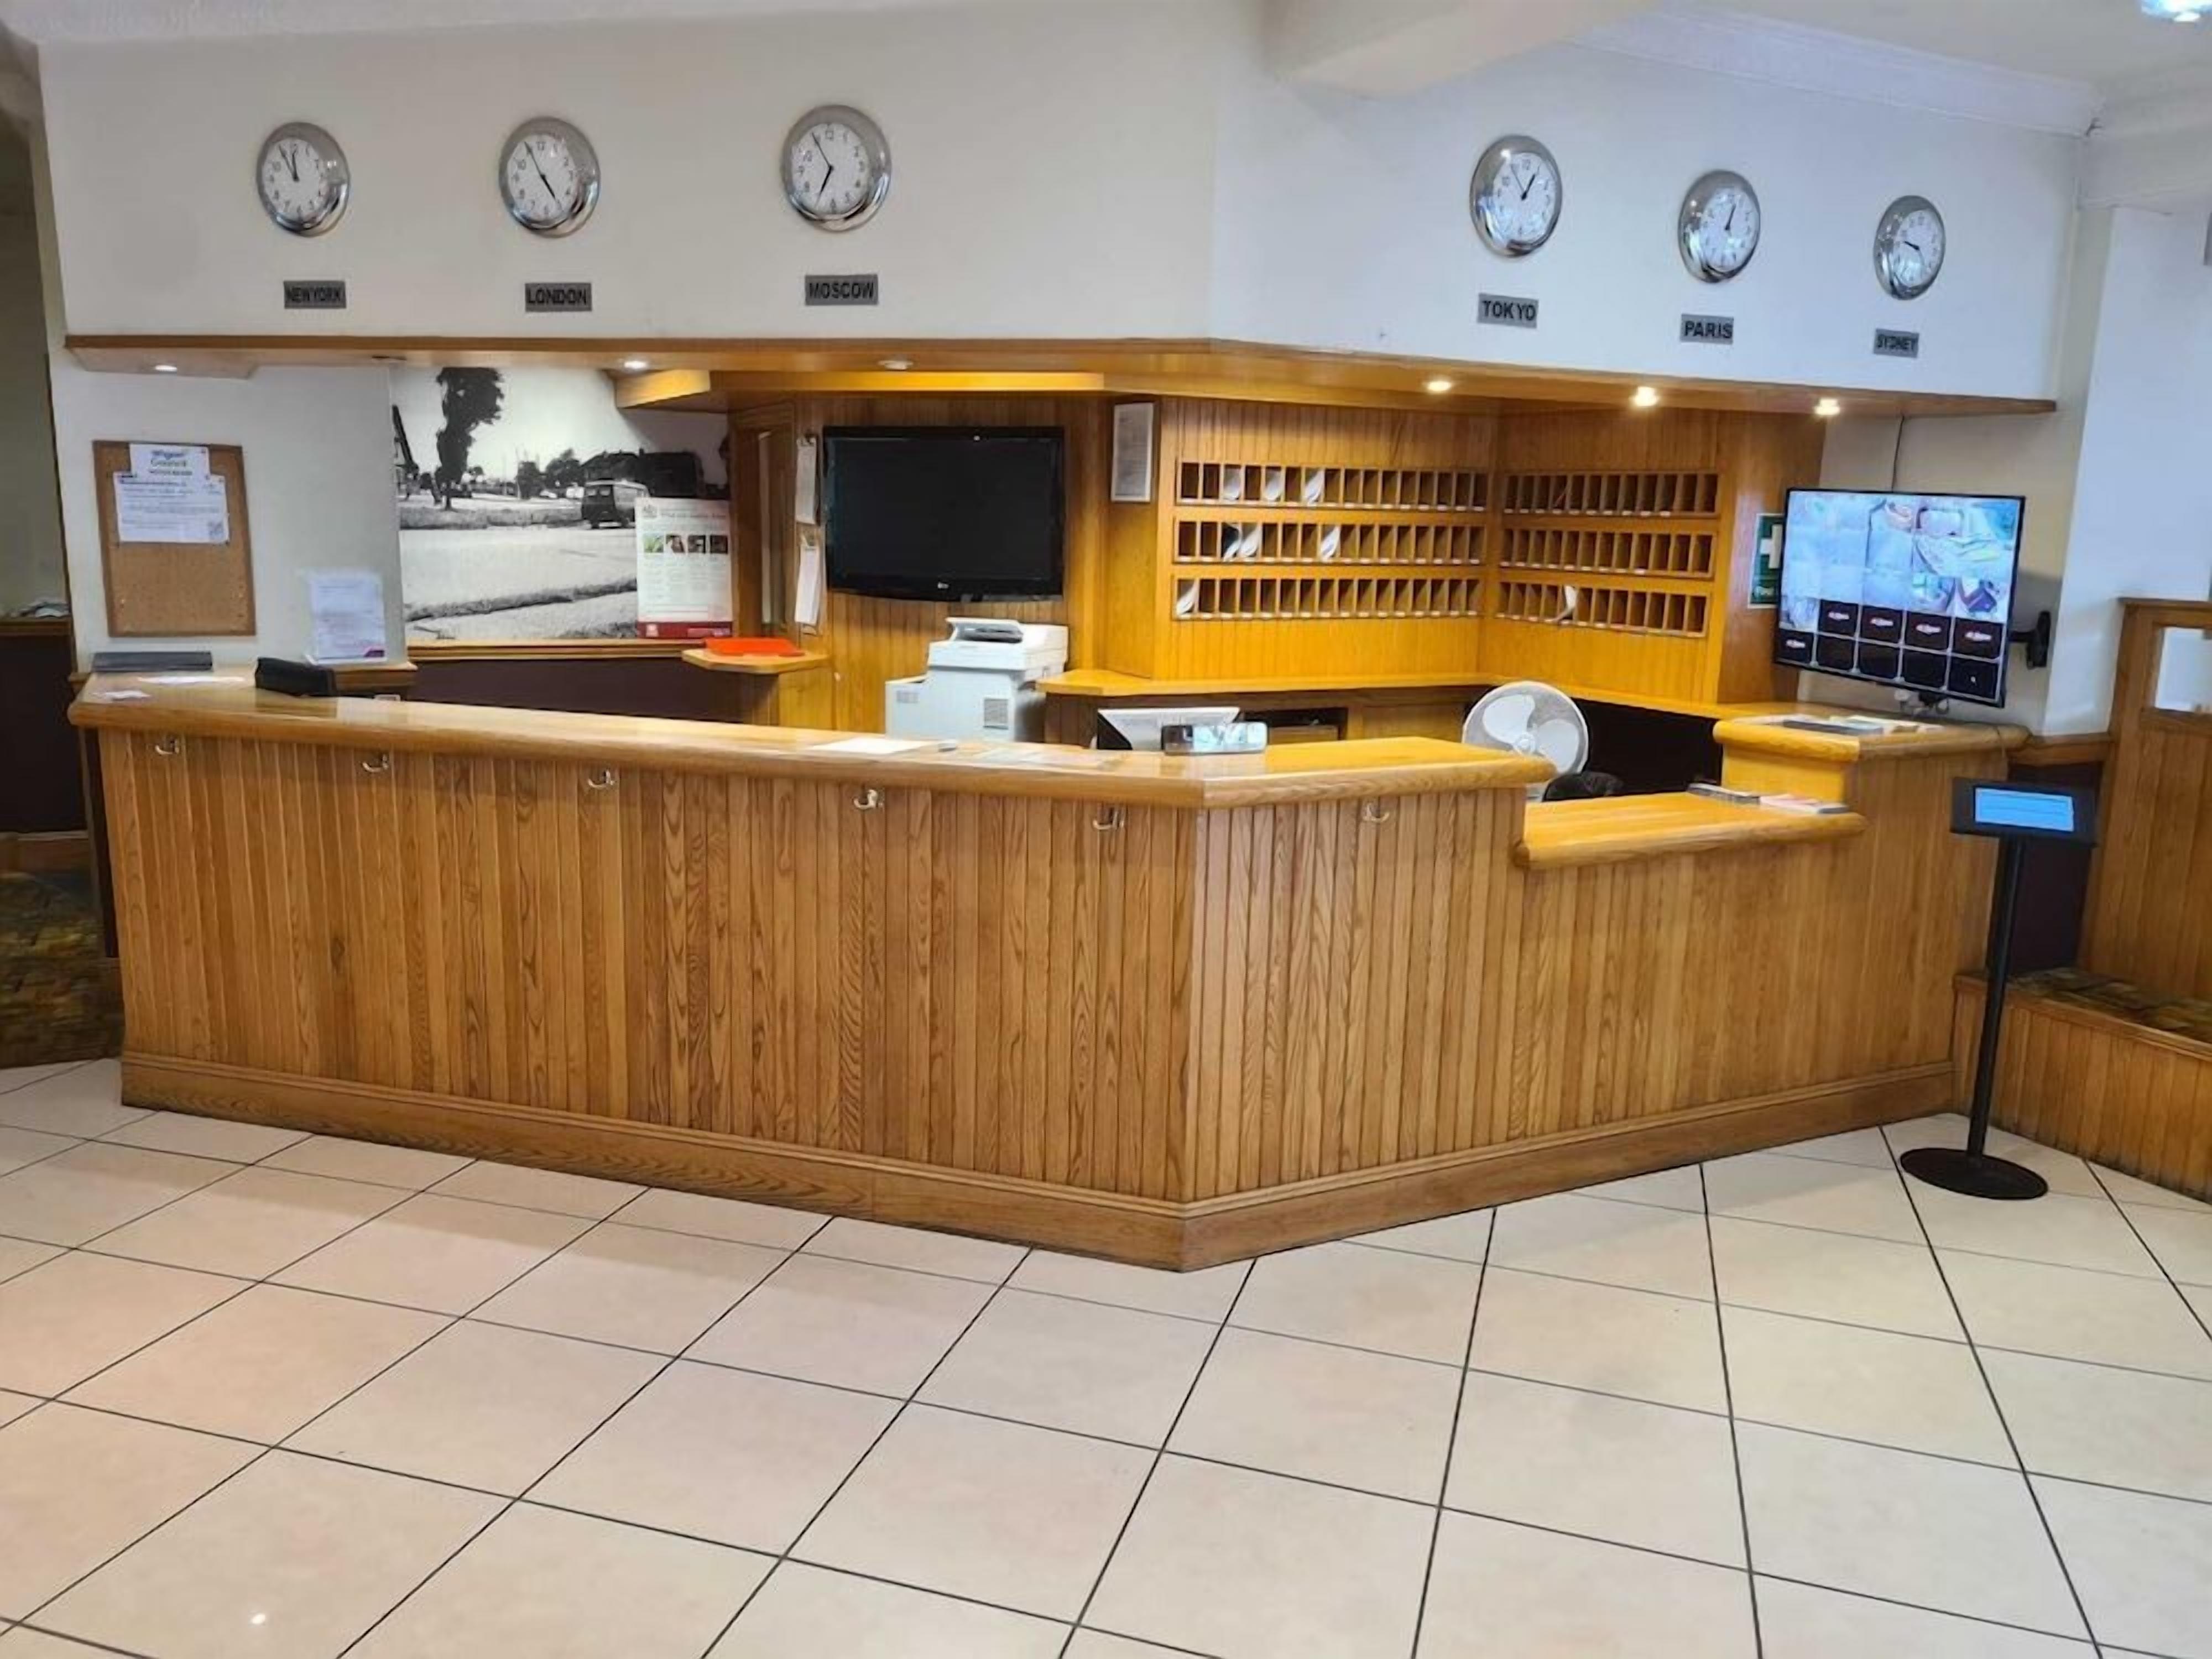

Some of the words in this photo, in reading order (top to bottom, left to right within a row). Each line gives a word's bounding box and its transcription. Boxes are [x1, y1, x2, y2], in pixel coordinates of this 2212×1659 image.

[528, 288, 586, 305] LONDON
[809, 281, 874, 299] MOSCOW
[1482, 300, 1536, 321] TOKYO
[1684, 321, 1733, 338] PARIS
